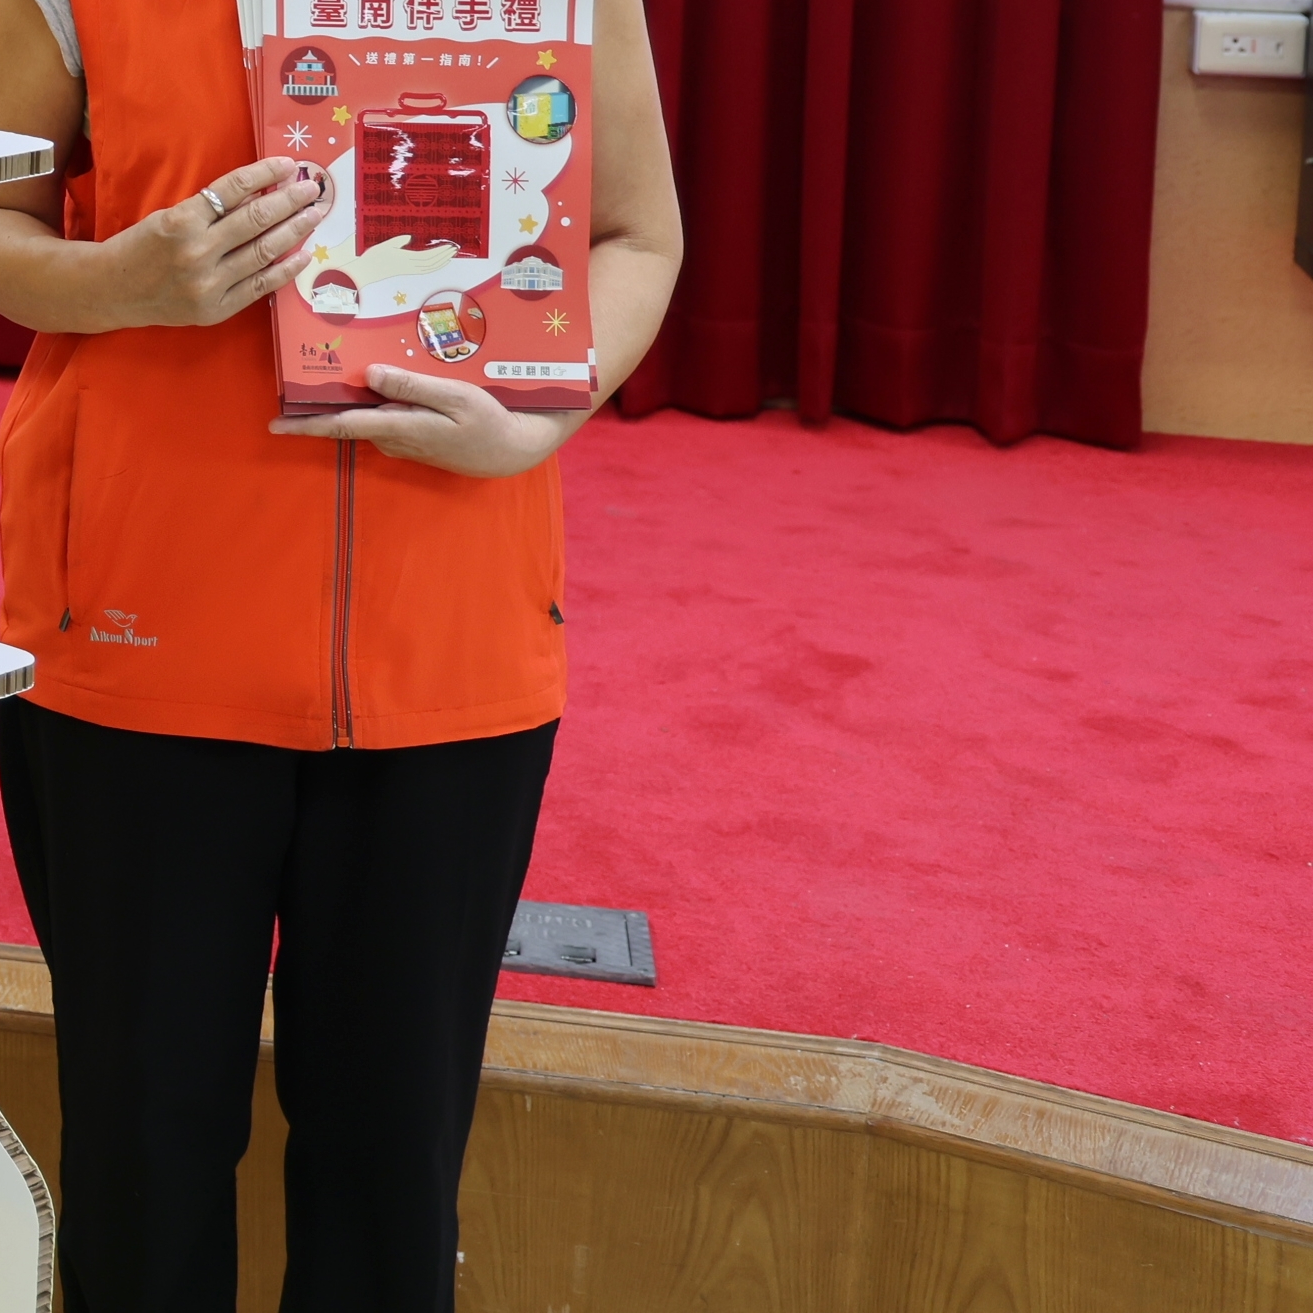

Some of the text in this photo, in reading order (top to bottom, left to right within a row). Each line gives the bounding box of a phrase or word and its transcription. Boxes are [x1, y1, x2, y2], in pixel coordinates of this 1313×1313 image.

[365, 50, 483, 69] 送禮第一指南!
[496, 364, 552, 379] 歡迎翻閱
[89, 625, 159, 648] Aikon Sport
